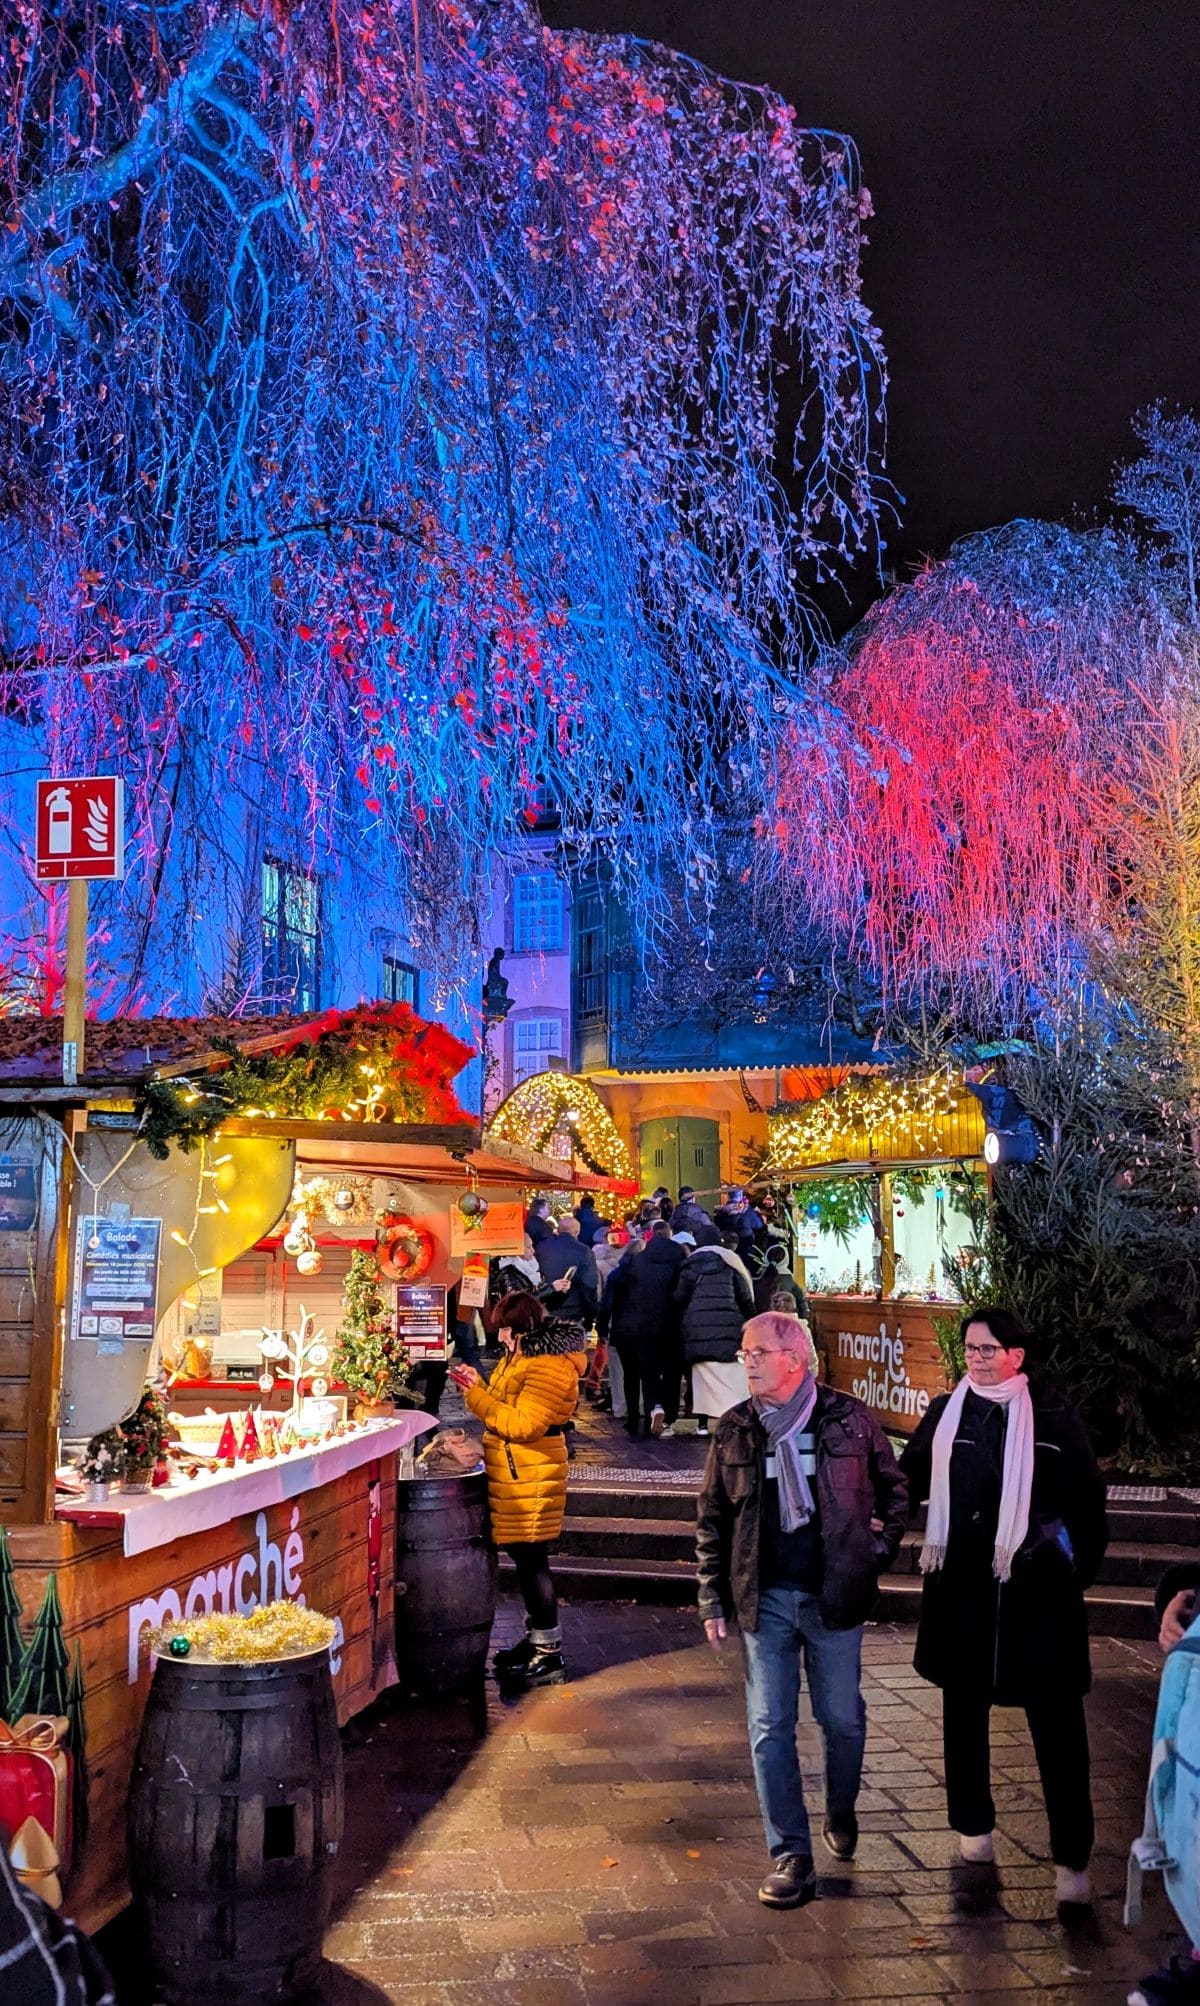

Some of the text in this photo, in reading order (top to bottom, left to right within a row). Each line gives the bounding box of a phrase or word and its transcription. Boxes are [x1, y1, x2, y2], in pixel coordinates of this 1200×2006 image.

[106, 1232, 138, 1242] Balade
[121, 1252, 155, 1260] musicales
[838, 1323, 906, 1383] marché
[852, 1367, 930, 1418] solidaire
